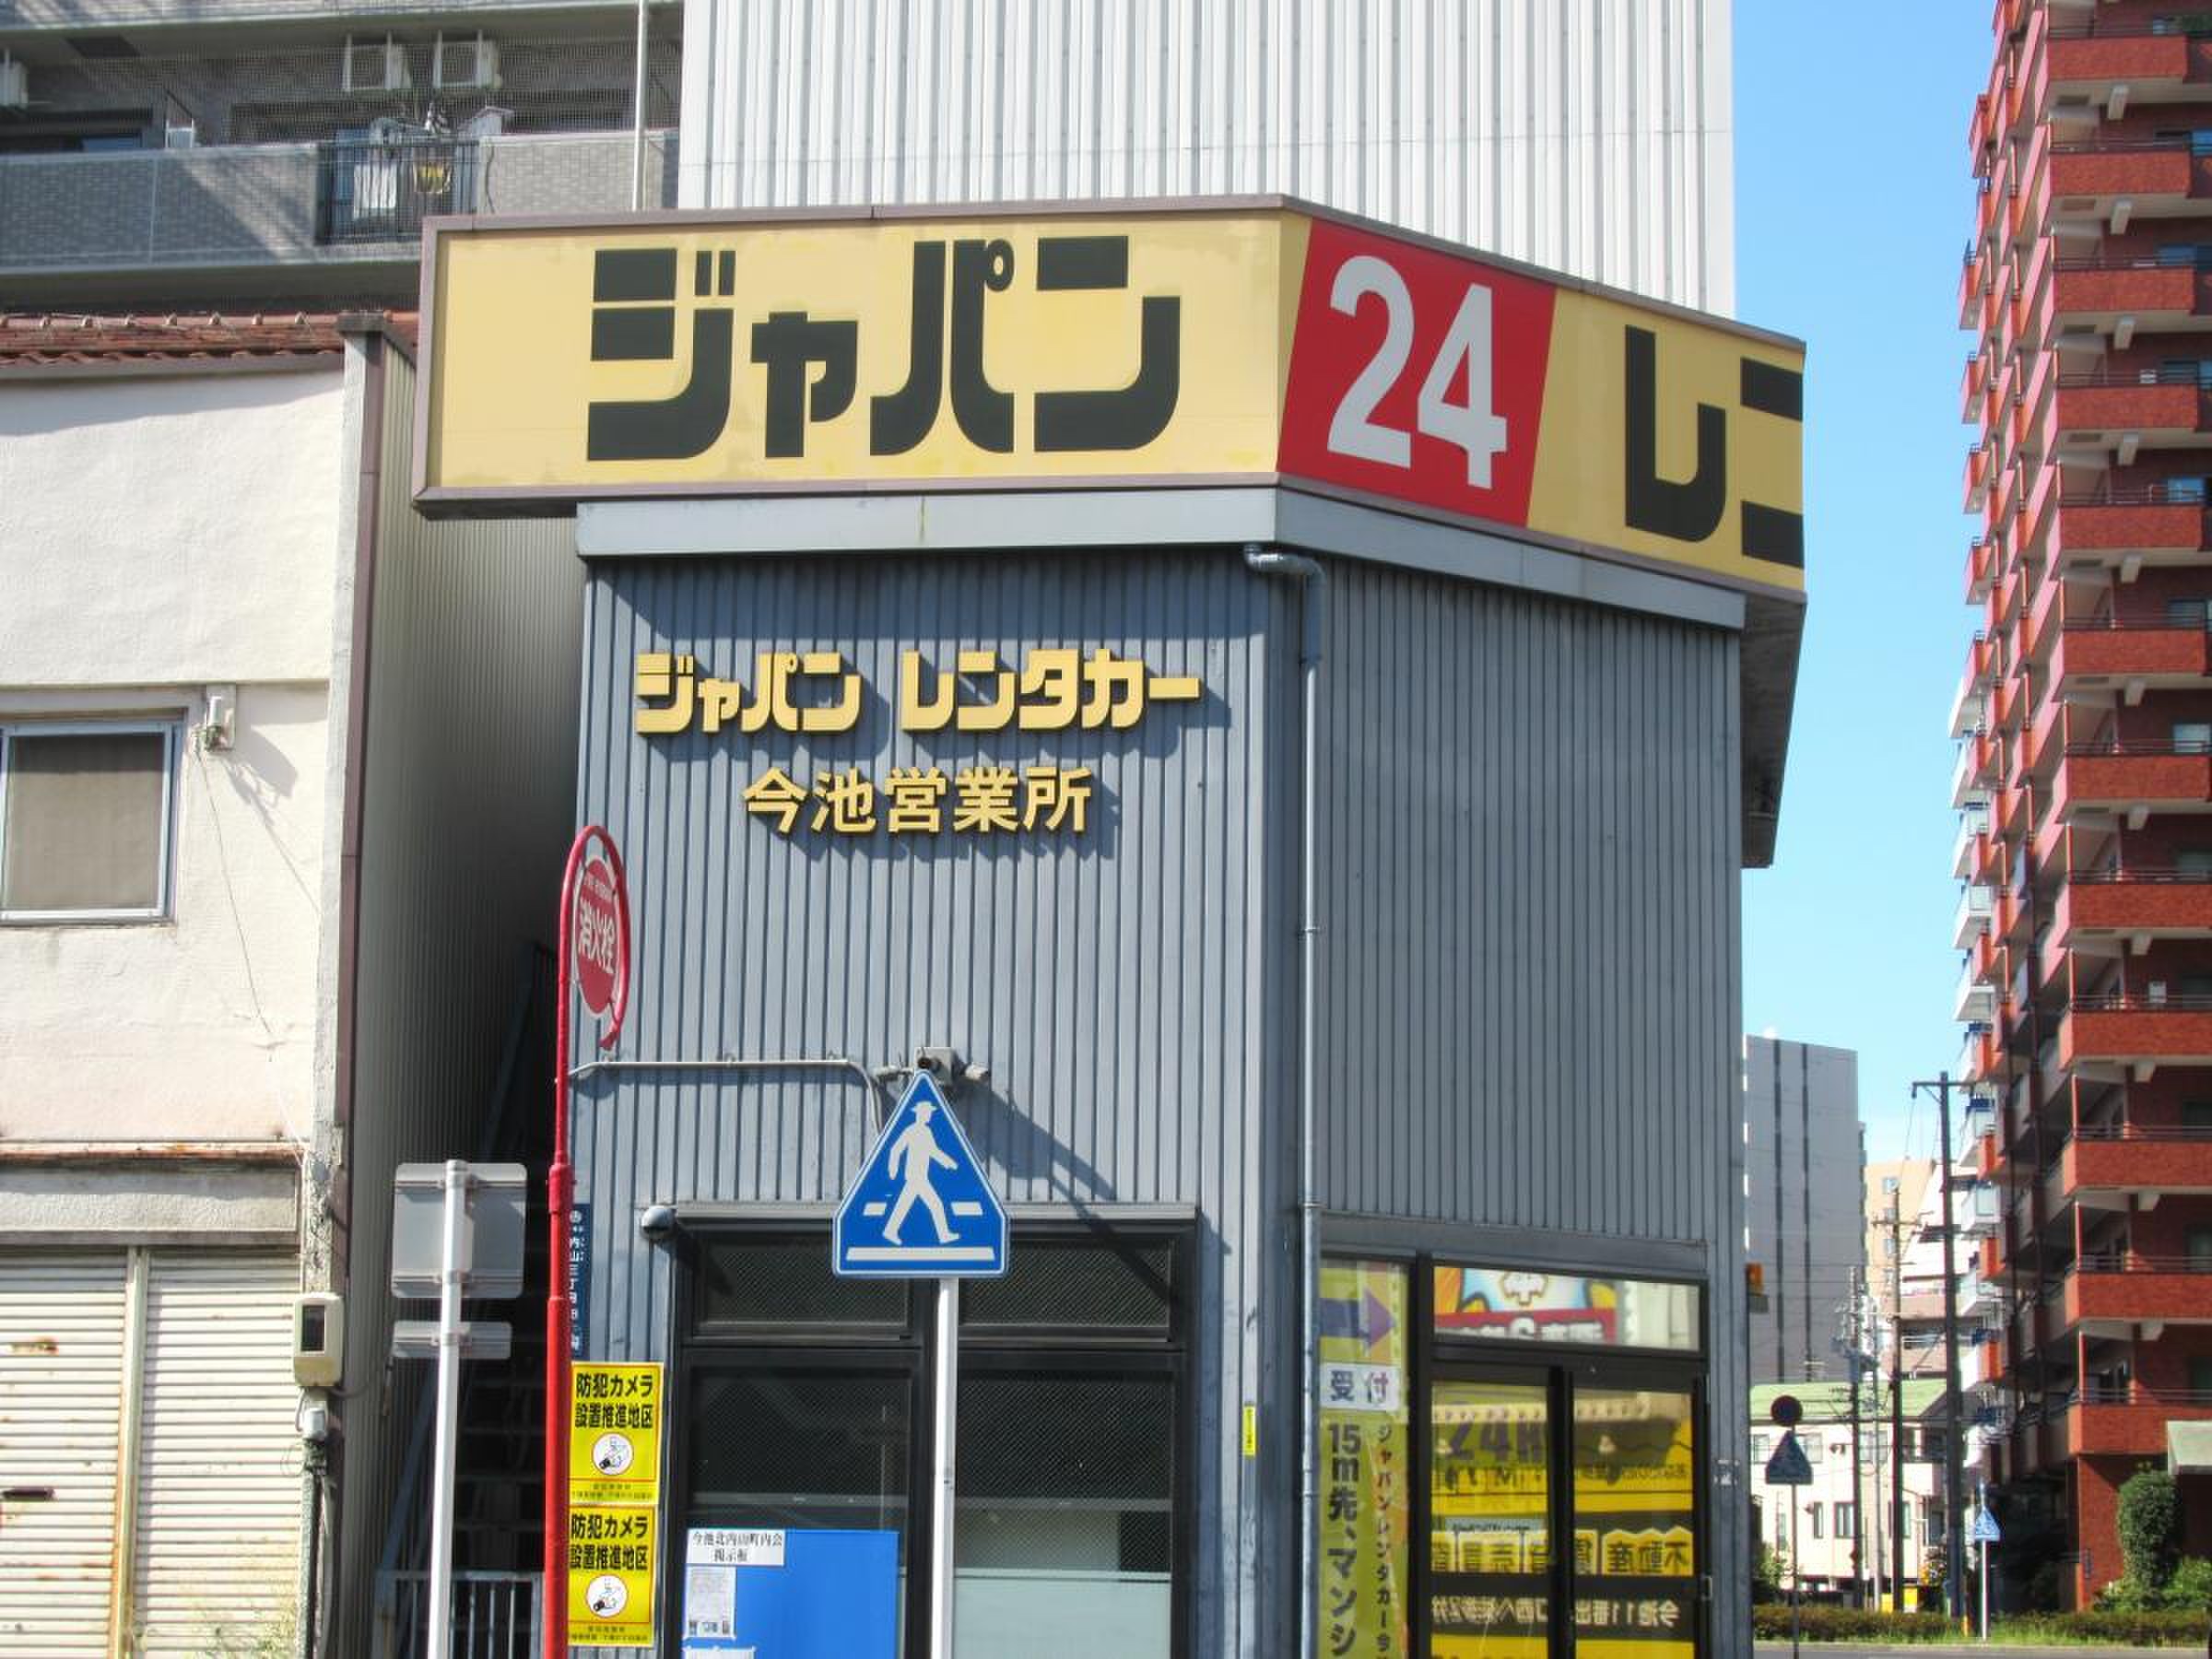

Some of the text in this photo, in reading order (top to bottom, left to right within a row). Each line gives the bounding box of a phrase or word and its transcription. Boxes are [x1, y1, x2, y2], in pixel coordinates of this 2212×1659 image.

[587, 234, 1181, 461] ジャパン
[1326, 254, 1507, 490] 24
[634, 647, 1202, 735] ジャパン レンタカー
[742, 766, 1092, 835] 今池営業所
[576, 1372, 653, 1398] 防犯カメラ
[1330, 1370, 1390, 1403] 受付
[574, 1403, 653, 1429] 設置推進地区
[571, 1514, 648, 1539] 防犯カメラ
[570, 1544, 648, 1571] 設置推進地区
